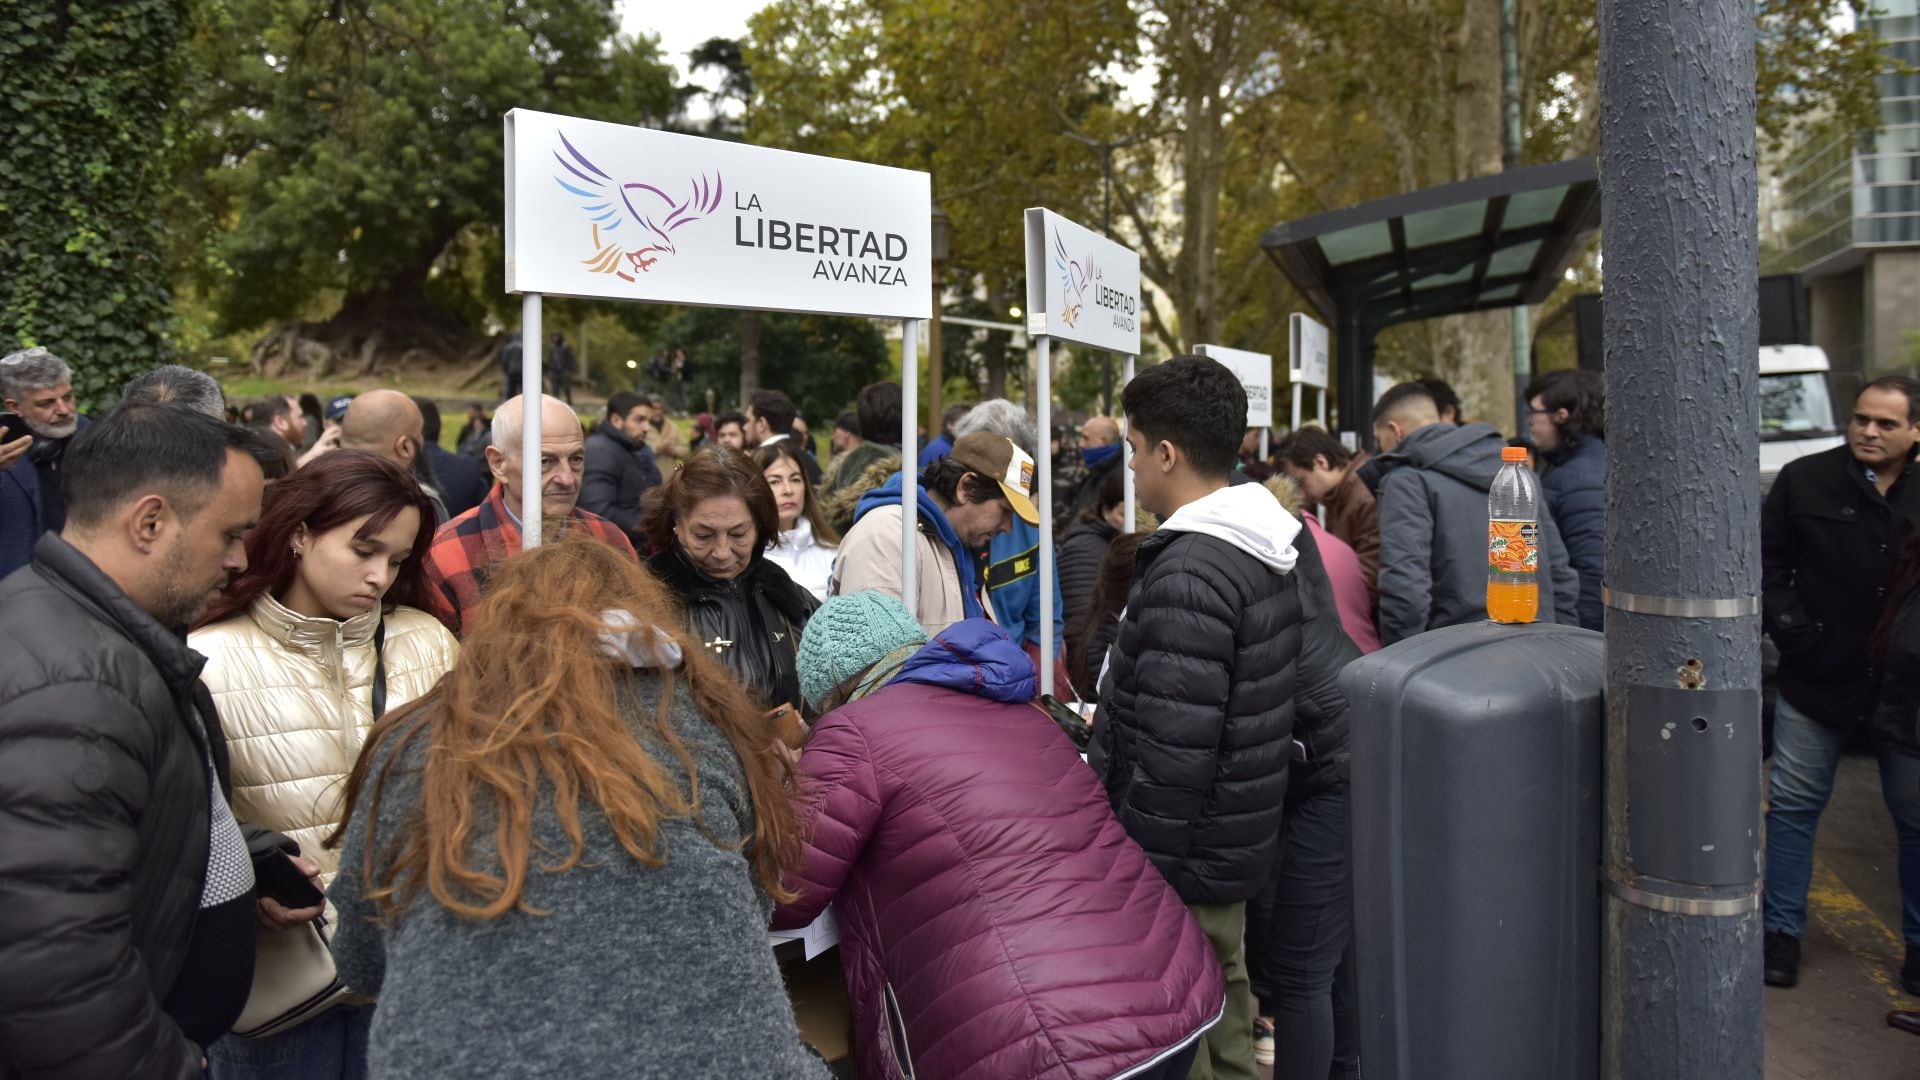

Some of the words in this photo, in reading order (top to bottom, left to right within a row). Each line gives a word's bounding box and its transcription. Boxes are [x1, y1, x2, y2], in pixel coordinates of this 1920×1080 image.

[735, 191, 763, 213] LA
[735, 215, 908, 262] LIBERTAD
[812, 259, 908, 287] AVANZA
[1095, 266, 1103, 281] LA
[1095, 283, 1135, 316] LIBERTAD
